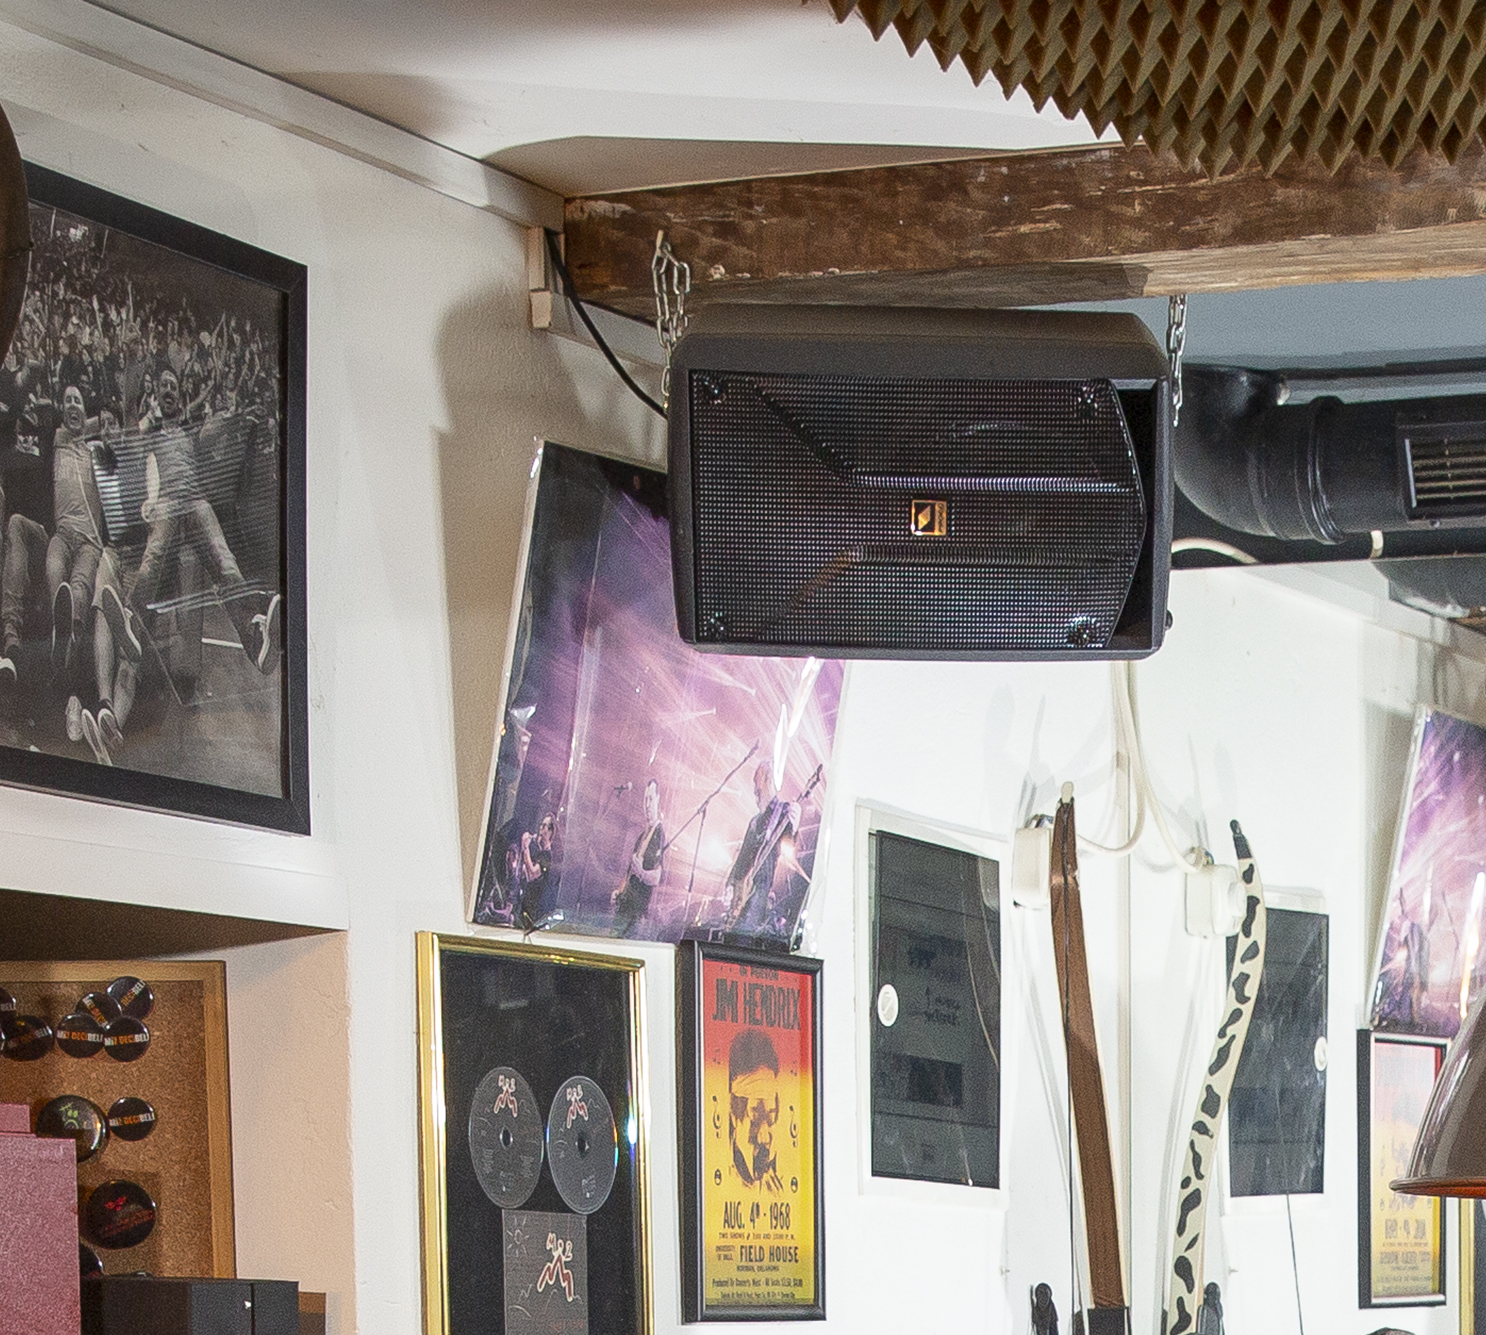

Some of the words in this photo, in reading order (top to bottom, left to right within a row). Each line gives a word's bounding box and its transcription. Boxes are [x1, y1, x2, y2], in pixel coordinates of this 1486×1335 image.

[723, 1201, 745, 1230] AUG.
[769, 1202, 791, 1230] 1968
[740, 1245, 765, 1262] FIELD
[769, 1245, 799, 1263] HOUSE
